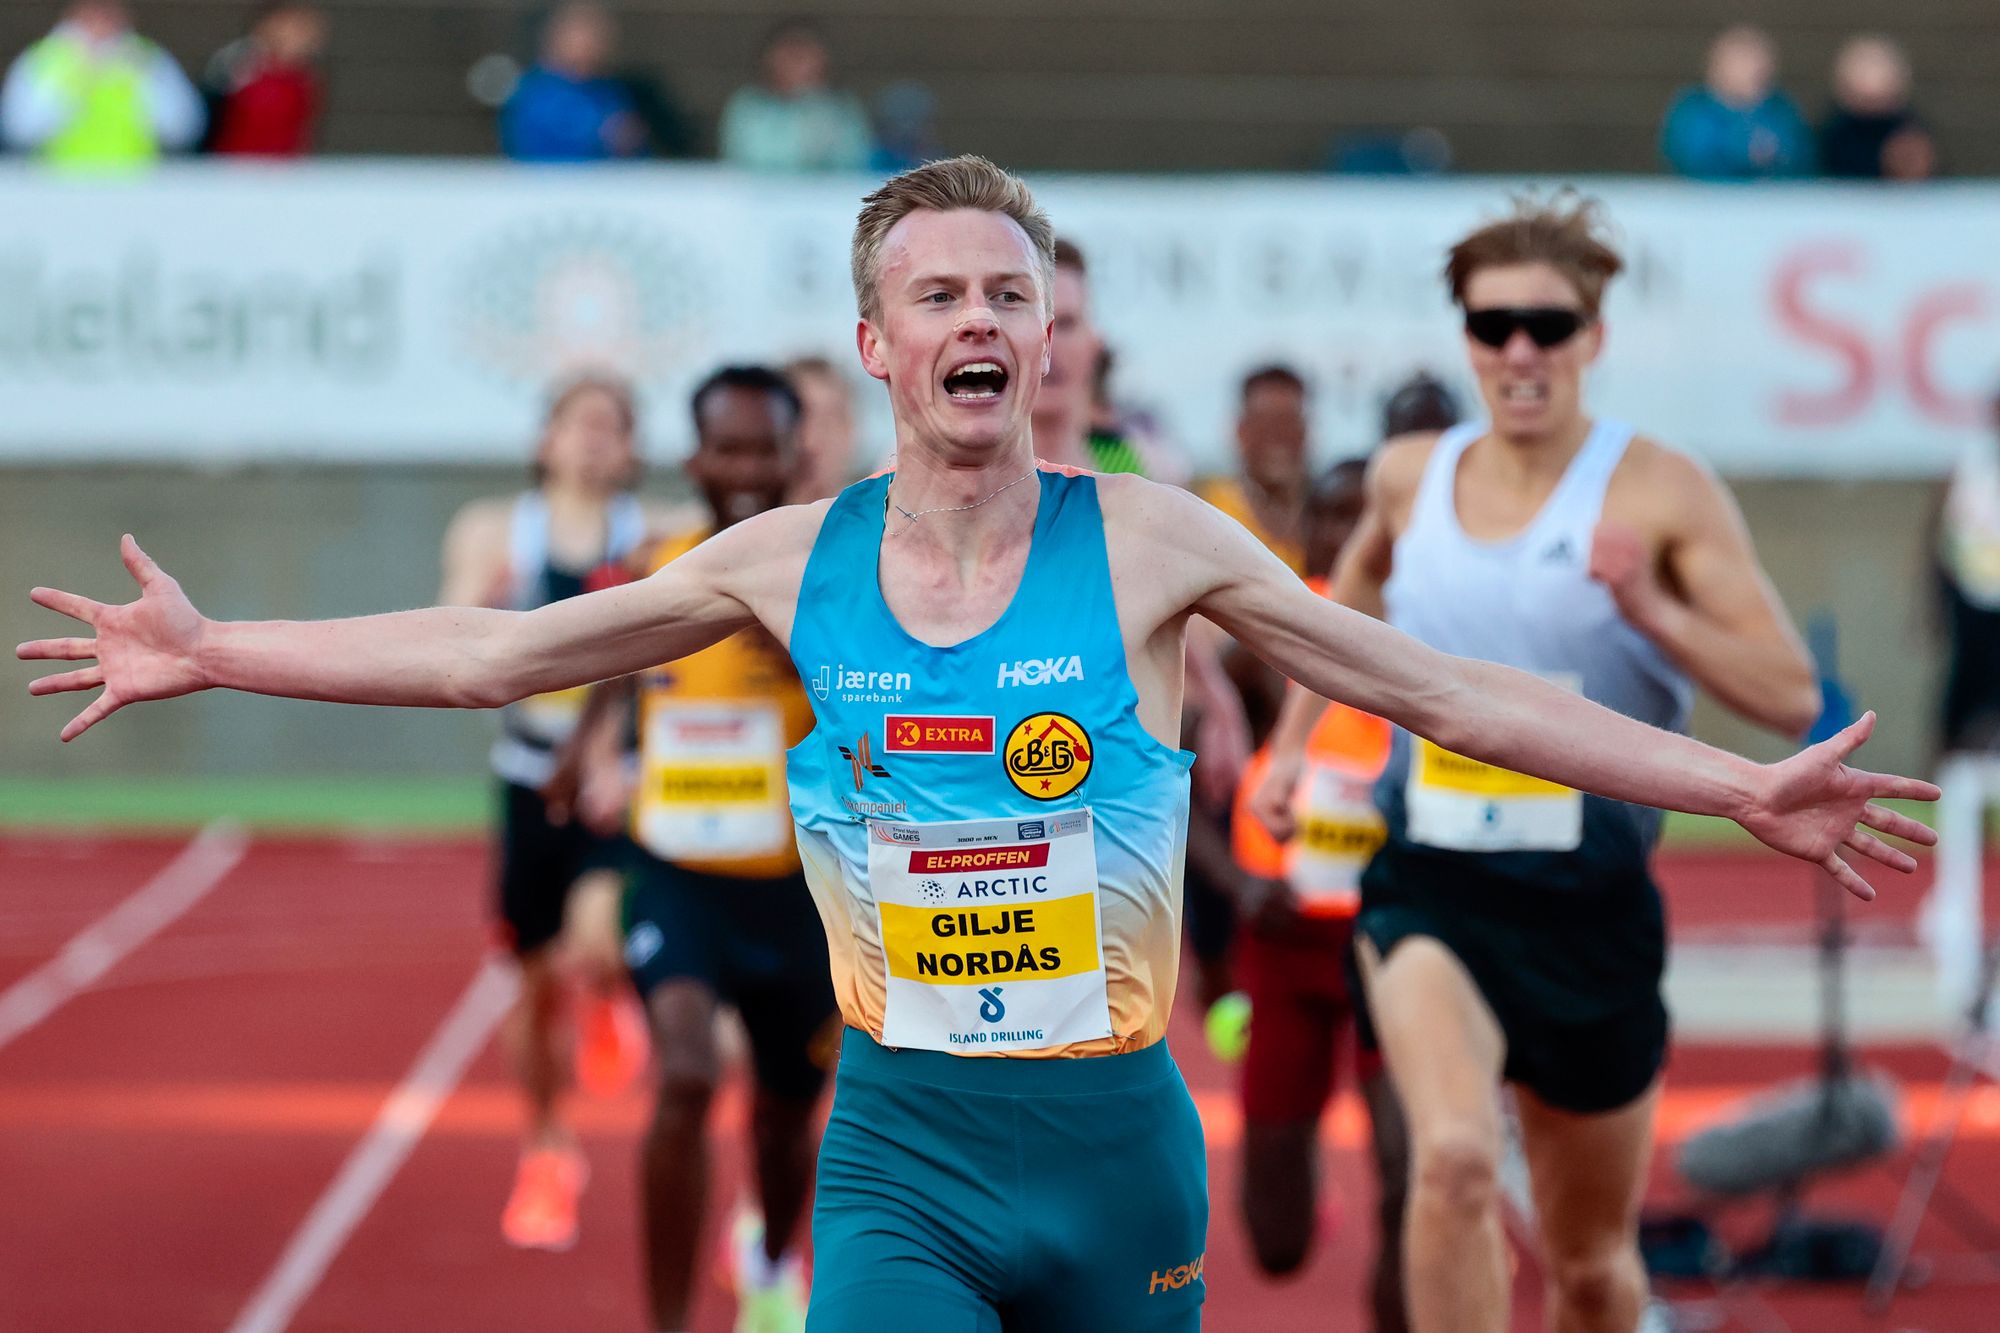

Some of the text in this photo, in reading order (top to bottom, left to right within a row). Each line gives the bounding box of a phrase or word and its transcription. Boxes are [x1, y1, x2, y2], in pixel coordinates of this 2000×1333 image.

[836, 664, 911, 690] jæren
[997, 655, 1084, 688] HOKA
[842, 692, 902, 703] sparebank
[925, 728, 983, 742] EXTRA
[893, 833, 920, 841] GAMES
[927, 851, 1030, 868] EL-PROFFEN
[958, 876, 1048, 898] ARCTIC
[932, 909, 1035, 937] GILJE
[917, 944, 1061, 976] NORDÅS
[949, 1029, 1043, 1043] ISLAND DRILLING
